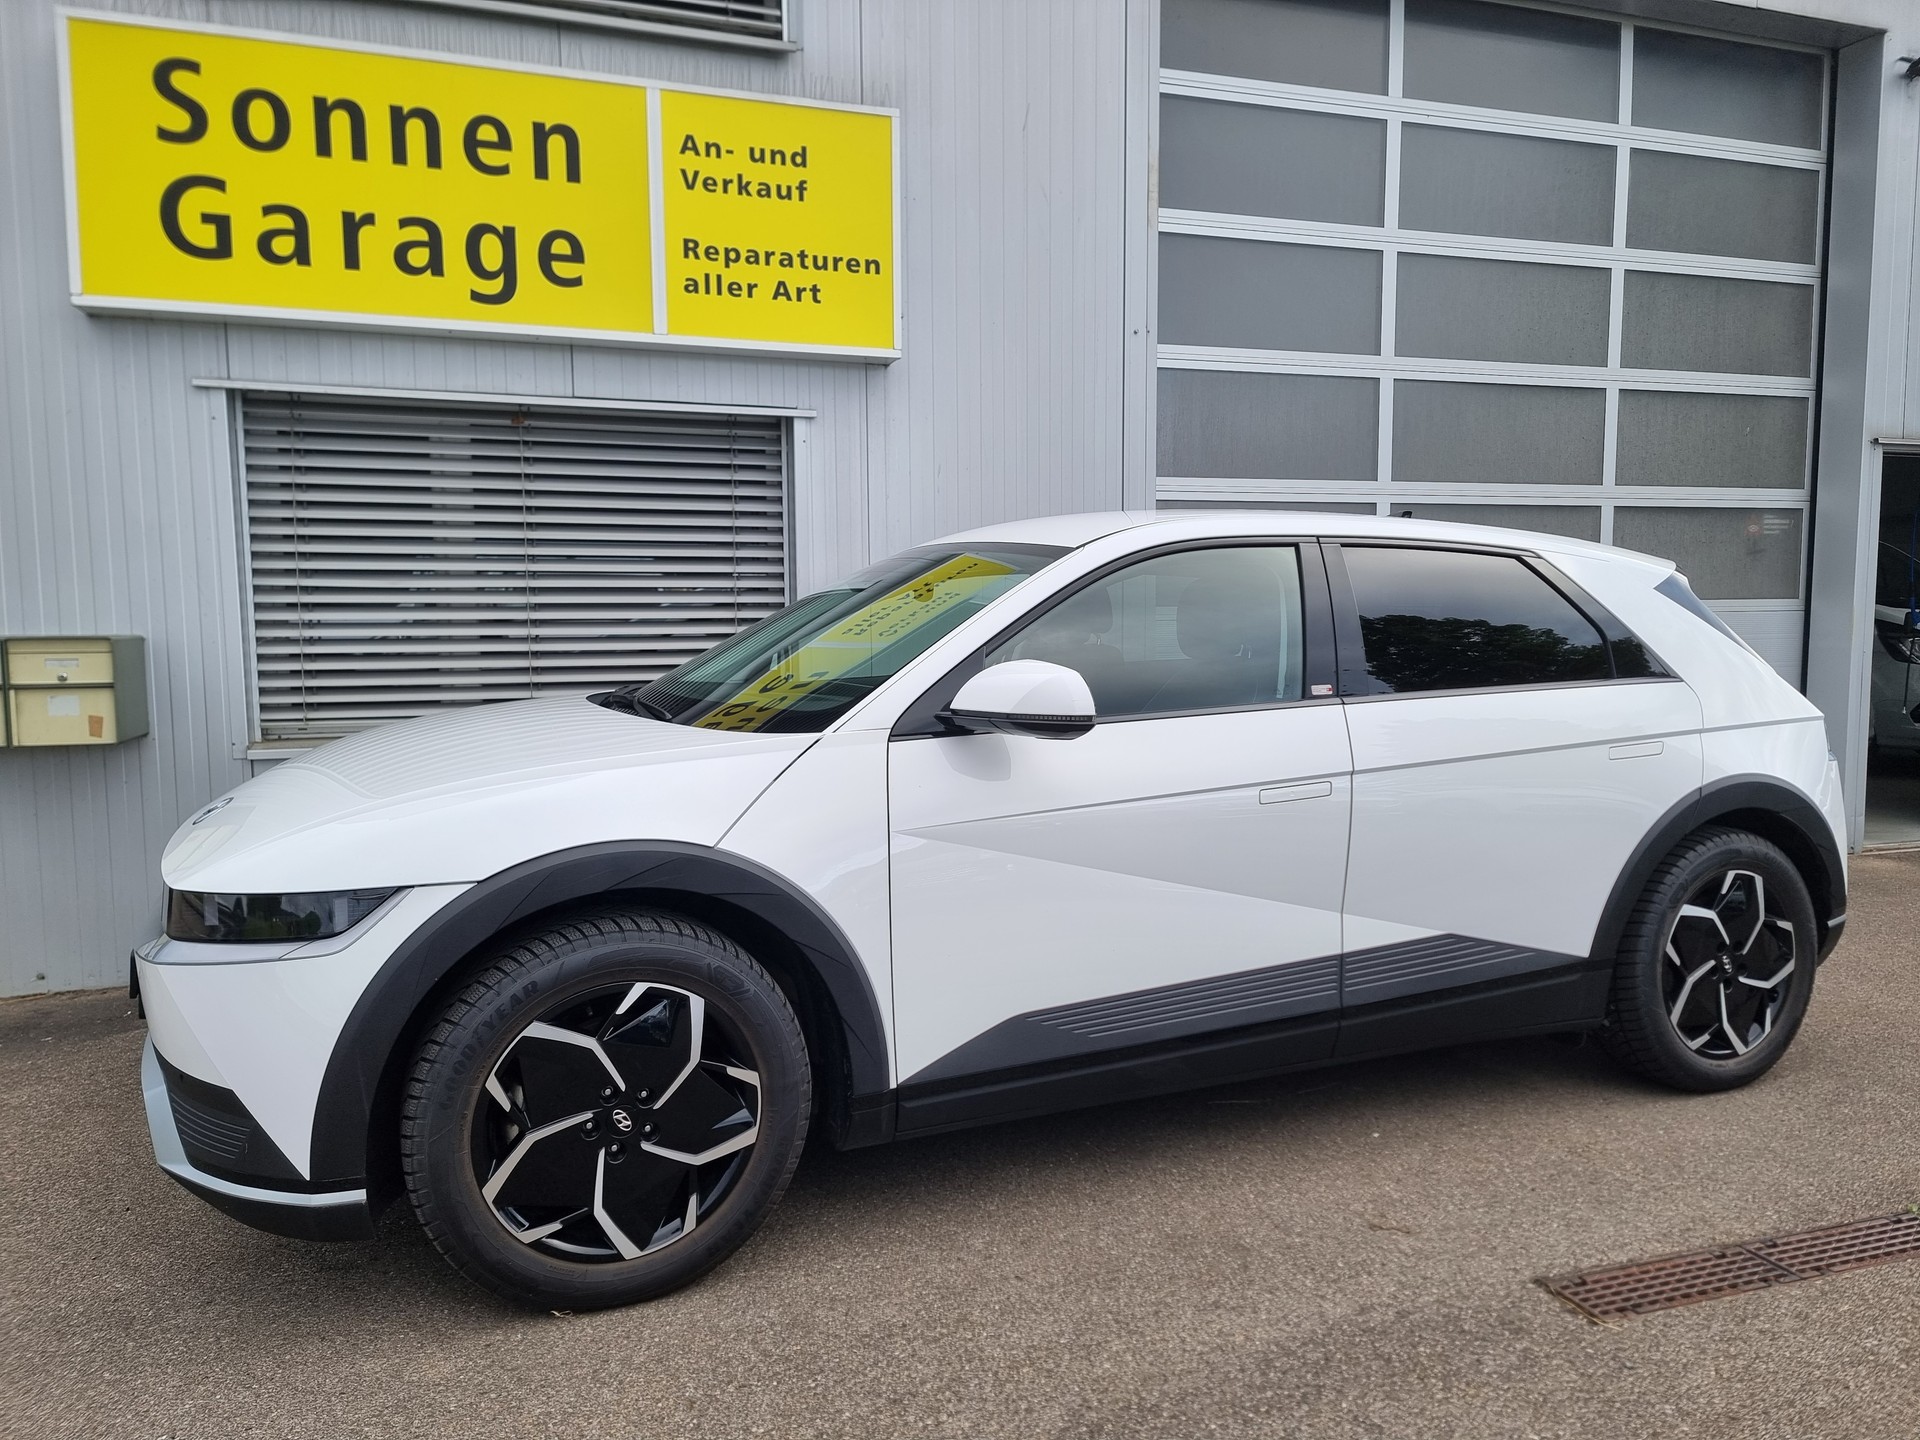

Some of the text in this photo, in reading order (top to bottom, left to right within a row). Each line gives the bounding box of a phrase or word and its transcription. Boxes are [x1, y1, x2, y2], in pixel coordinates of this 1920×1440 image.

[152, 57, 581, 184] Sonnen
[679, 134, 808, 168] An- und
[680, 168, 808, 202] Verkauf
[159, 174, 585, 306] Garage
[683, 238, 881, 275] Reparaturen
[683, 272, 821, 304] aller Art
[439, 980, 540, 1110] GOODYEAR
